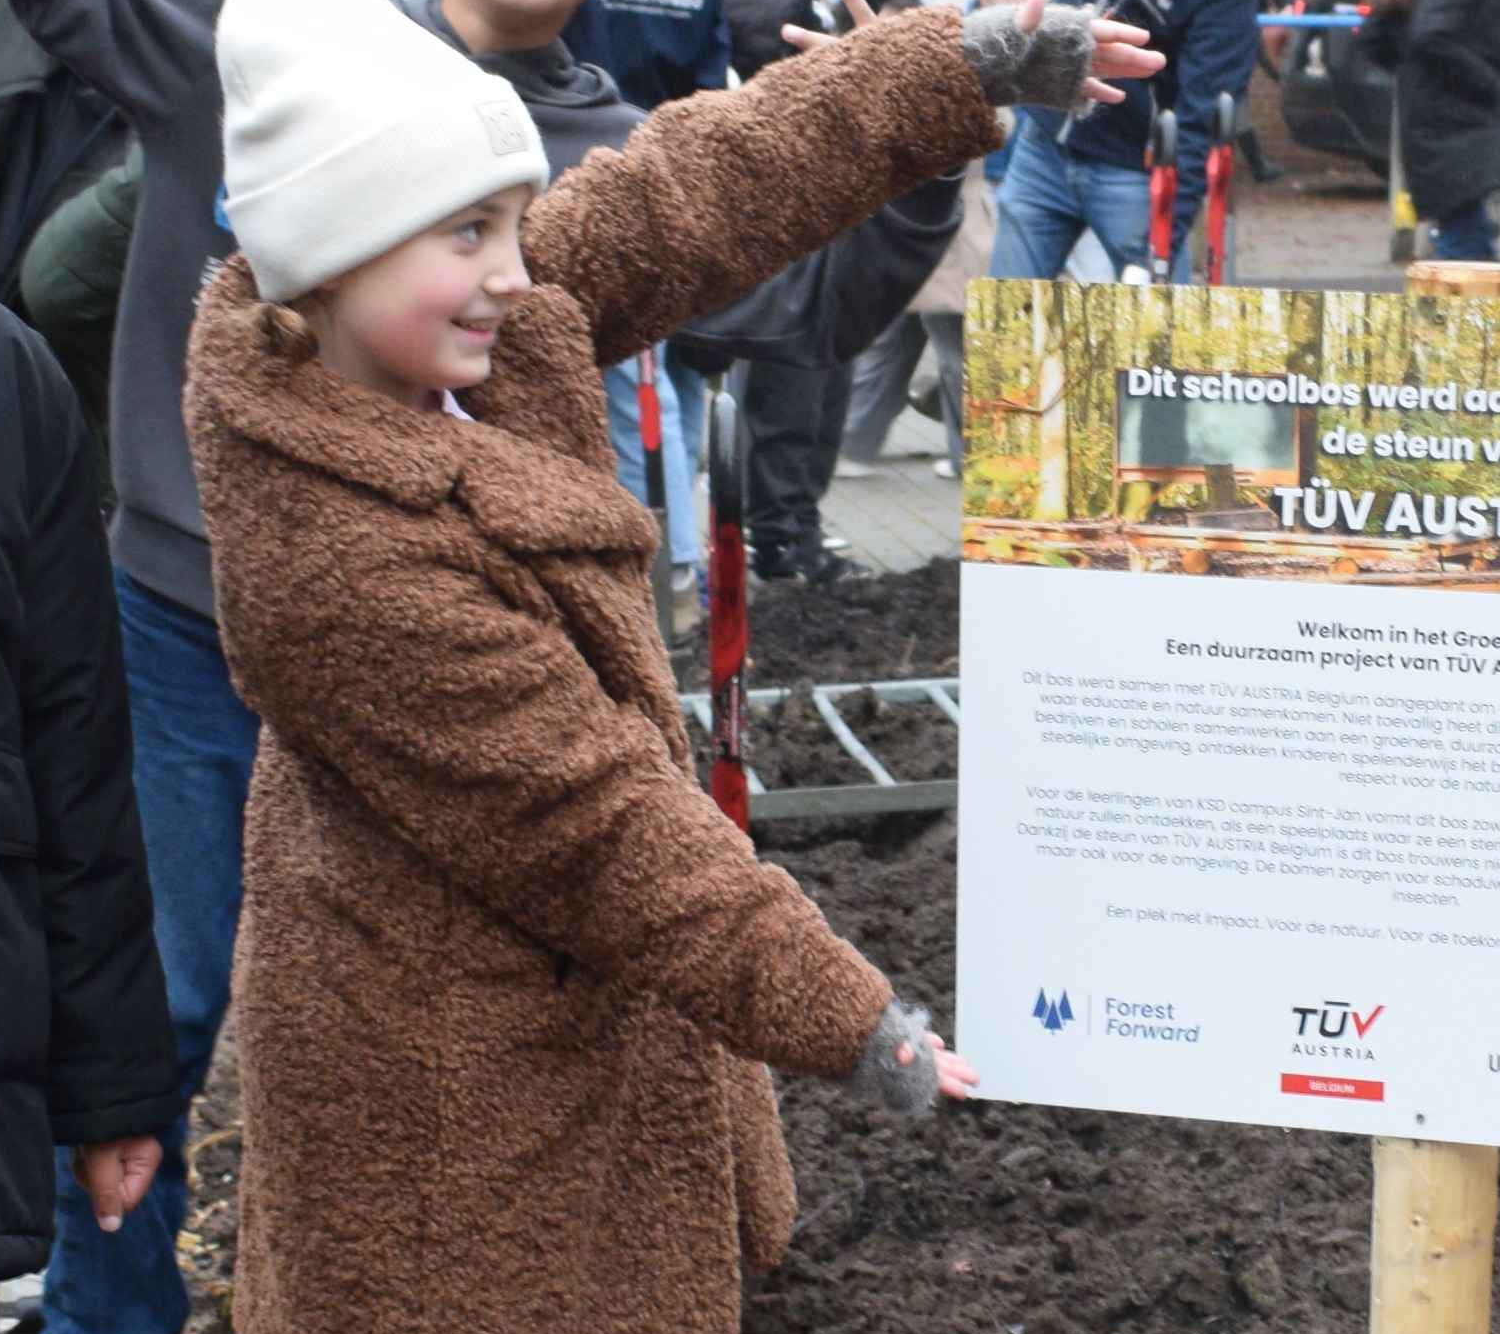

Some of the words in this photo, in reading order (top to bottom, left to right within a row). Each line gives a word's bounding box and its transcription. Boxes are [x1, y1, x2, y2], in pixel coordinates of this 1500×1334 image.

[1127, 368, 1177, 398] Dit
[1182, 371, 1362, 408] schoolbos
[1368, 380, 1457, 412] werd
[1322, 427, 1366, 456] de
[1374, 434, 1474, 462] steun
[1273, 476, 1377, 531] TÜV
[1297, 620, 1383, 642] Welkom
[1388, 624, 1408, 644] in
[1412, 626, 1448, 646] het
[1165, 638, 1202, 657] Een
[1206, 640, 1315, 664] duurzaam
[1318, 648, 1395, 672] project
[1399, 655, 1440, 672] van
[1445, 652, 1486, 675] TÜV
[1039, 693, 1077, 706] waar
[1079, 693, 1149, 711] educatie
[1150, 700, 1171, 713] en
[1173, 701, 1225, 716] natuur
[1340, 710, 1372, 726] Niet
[1375, 713, 1443, 735] toevallig
[1445, 716, 1482, 733] heet
[1040, 729, 1111, 750] stedelijke
[1195, 740, 1277, 758] ontdekken
[1279, 744, 1348, 763] kinderen
[1350, 751, 1458, 774] spelenderwijs
[1459, 756, 1486, 773] het
[1338, 770, 1399, 788] respect
[1400, 775, 1435, 789] voor
[1438, 774, 1460, 790] de
[1026, 784, 1060, 800] Voor
[1062, 786, 1084, 802] de
[1086, 788, 1162, 810] leerlingen
[1163, 796, 1193, 810] van
[1227, 801, 1292, 820] campus
[1363, 811, 1411, 826] vormt
[1412, 811, 1435, 827] dit
[1437, 813, 1469, 830] bos
[1033, 805, 1085, 821] natuur
[1087, 808, 1132, 824] zullen
[1220, 817, 1243, 833] als
[1244, 821, 1276, 835] een
[1277, 824, 1369, 843] speelplaats
[1371, 831, 1411, 845] waar
[1414, 834, 1433, 847] ze
[1434, 835, 1467, 849] een
[1015, 821, 1068, 842] Dankzij
[1071, 825, 1093, 840] de
[1094, 828, 1137, 844] steun
[1140, 833, 1170, 846] van
[1204, 835, 1266, 853] AUSTRIA
[1268, 840, 1332, 860] Belgium
[1334, 844, 1348, 860] is
[1350, 845, 1371, 861] dit
[1372, 847, 1405, 864] bos
[1407, 851, 1480, 870] trouwens
[1036, 844, 1077, 858] maar
[1079, 846, 1108, 860] ook
[1110, 850, 1144, 863] voor
[1146, 849, 1168, 865] de
[1253, 858, 1276, 873] De
[1277, 859, 1335, 878] bomen
[1337, 867, 1392, 885] zorgen
[1393, 871, 1430, 885] voor
[1105, 904, 1132, 919] Een
[1134, 906, 1168, 924] plek
[1169, 911, 1201, 925] met
[1265, 916, 1302, 933] Voor
[1304, 919, 1326, 935] de
[1388, 926, 1424, 942] Voor
[1427, 928, 1449, 945] de
[1106, 997, 1175, 1020] Forest
[1106, 1018, 1200, 1043] Forward
[1292, 1043, 1376, 1061] AUSTRIA
